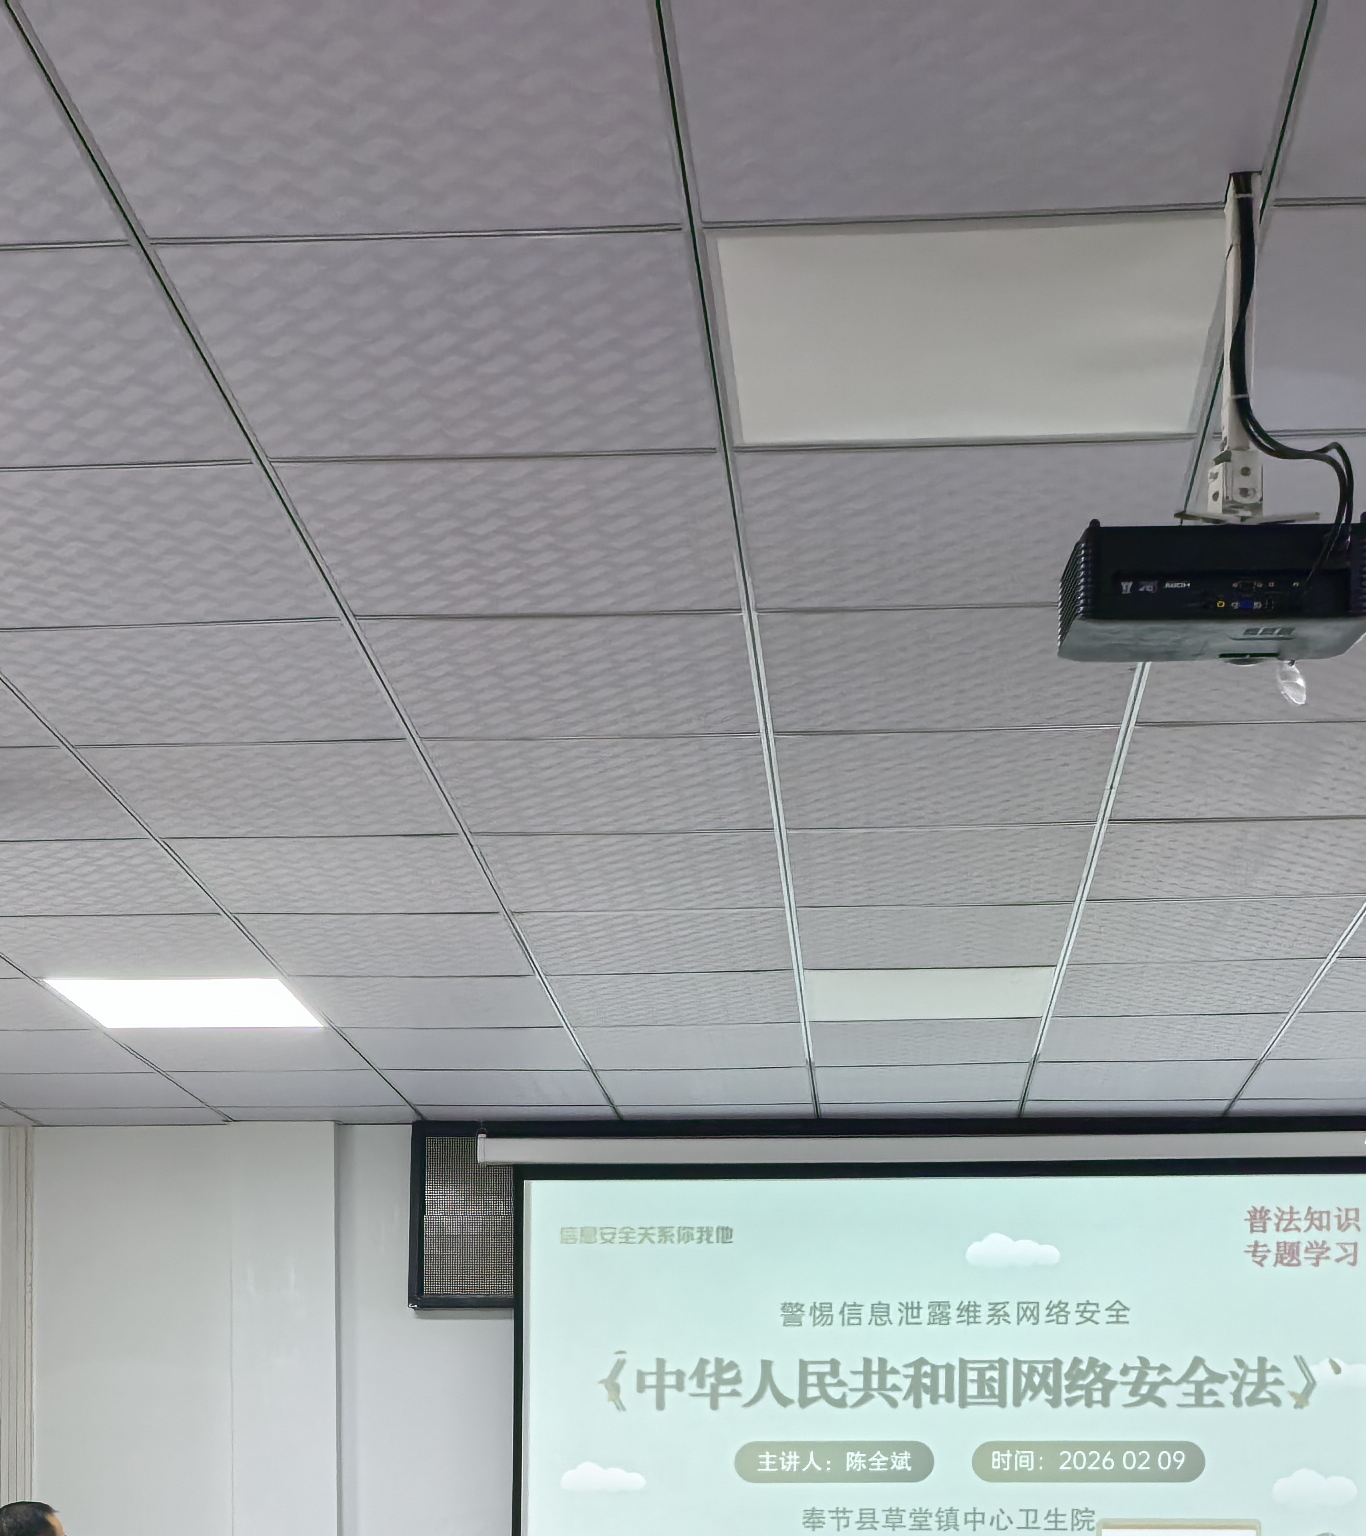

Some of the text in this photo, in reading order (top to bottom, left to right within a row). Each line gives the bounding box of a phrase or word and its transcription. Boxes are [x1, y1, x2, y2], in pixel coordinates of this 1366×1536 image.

[1244, 1205, 1362, 1234] 普法知识
[1243, 1240, 1360, 1268] 专题学习
[780, 1299, 1131, 1328] 警惕信息泄露维系网络安全
[599, 1351, 1317, 1413] 《中华人民共和国网络安全法》
[802, 1506, 1096, 1533] 奉节县草堂镇中心卫生院
